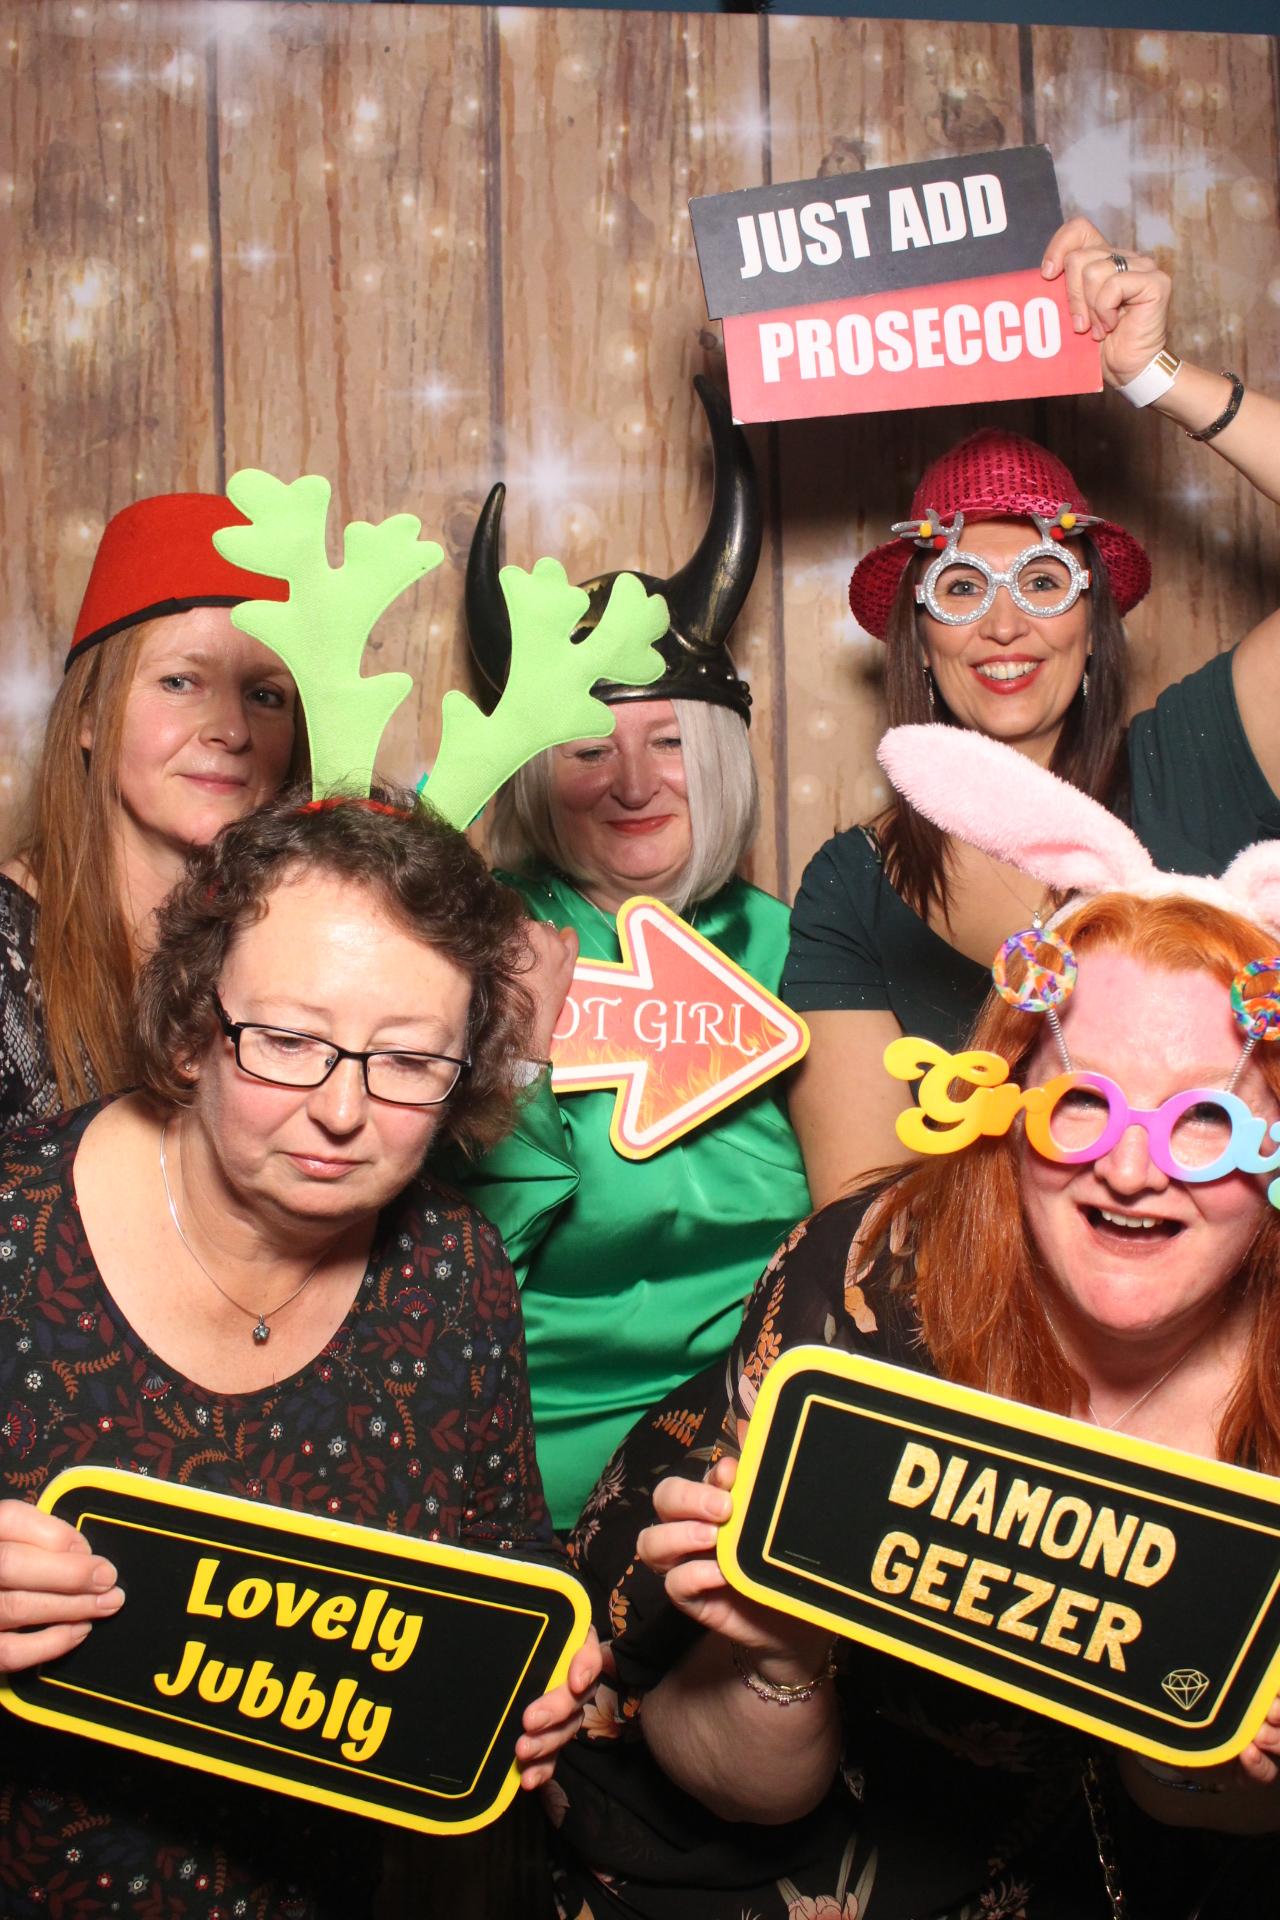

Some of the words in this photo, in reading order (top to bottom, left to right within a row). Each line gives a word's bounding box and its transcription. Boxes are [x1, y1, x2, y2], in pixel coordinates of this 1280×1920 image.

[736, 194, 871, 280] JUST
[888, 173, 1008, 252] ADD
[758, 296, 1062, 384] PROSECCO
[551, 996, 623, 1040] OT
[632, 999, 759, 1057] GIRL
[887, 1441, 1177, 1588] DIAMOND
[186, 1557, 424, 1672] Lovely
[869, 1530, 1143, 1673] GEEZER
[153, 1640, 392, 1763] Jubbly
